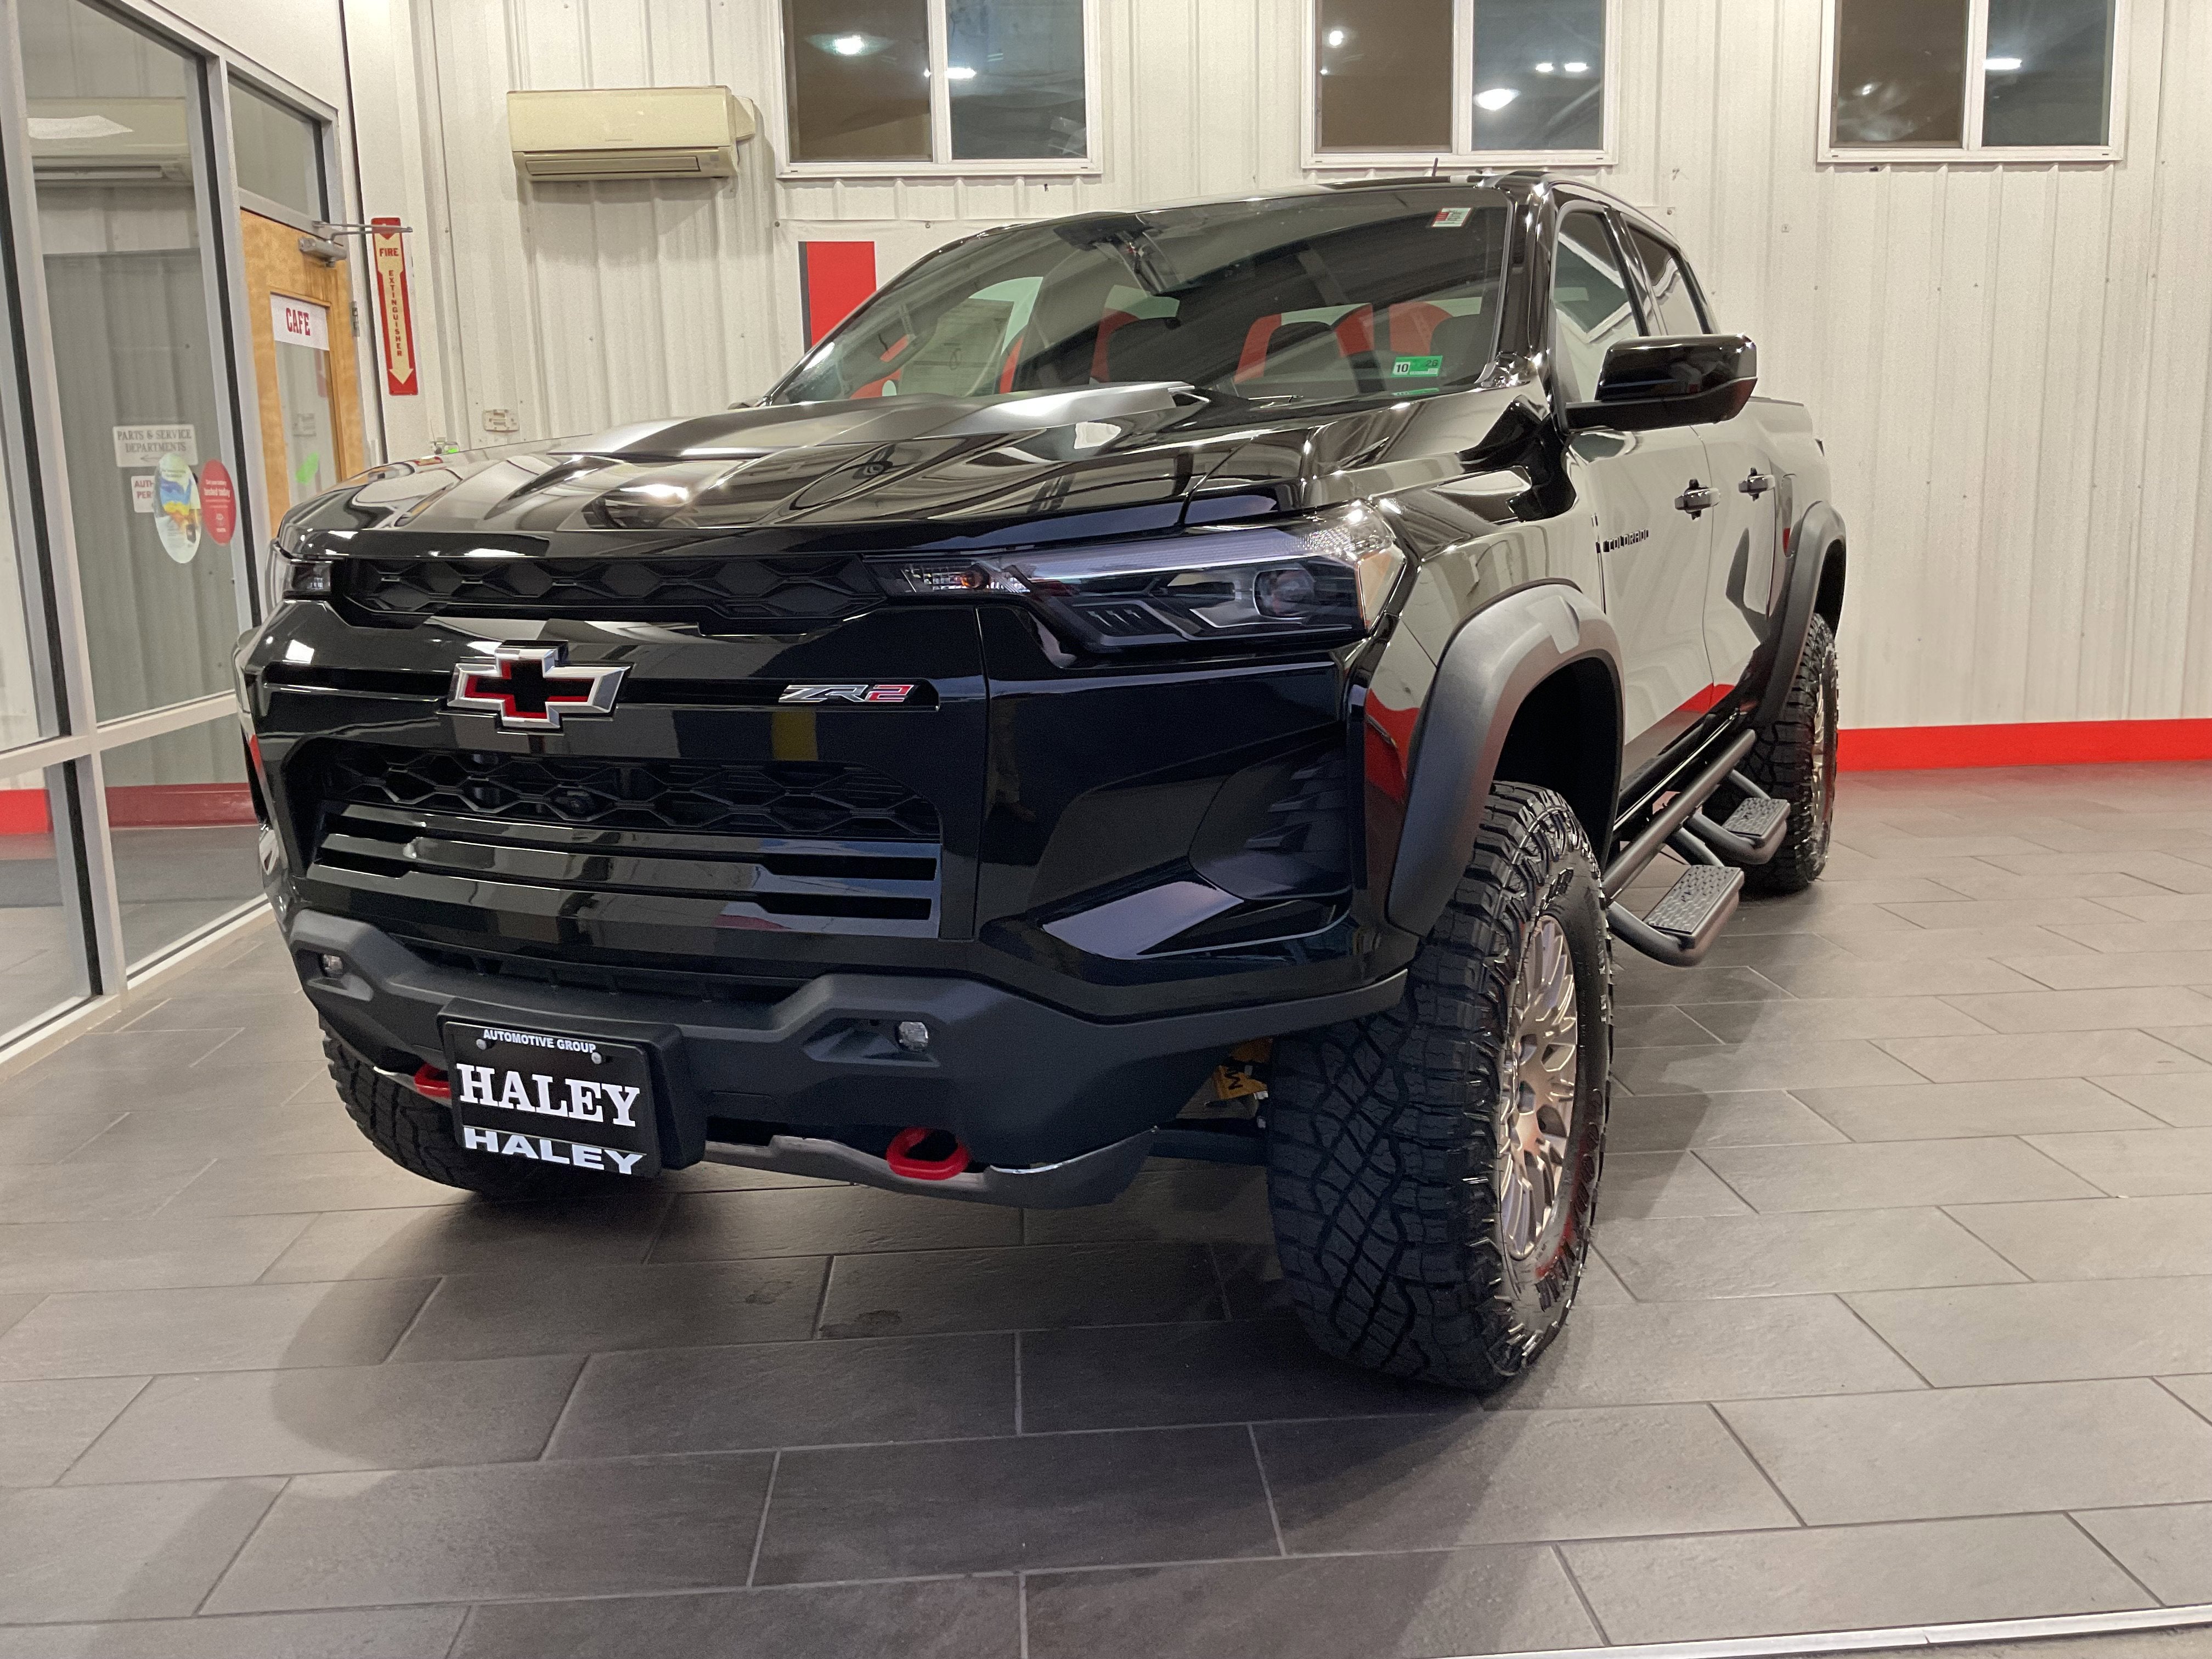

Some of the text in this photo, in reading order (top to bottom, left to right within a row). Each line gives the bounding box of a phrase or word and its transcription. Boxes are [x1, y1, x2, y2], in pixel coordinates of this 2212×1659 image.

[379, 247, 399, 257] FIRE
[285, 307, 311, 336] CAFE
[388, 270, 403, 357] EXTINGUISHER
[1396, 364, 1409, 373] 10
[117, 429, 191, 441] PARTS & SERVICE
[125, 442, 187, 453] DEPARTMENTS
[778, 684, 914, 703] ZR2
[483, 1029, 596, 1054] AUTOMOTIVE GROUP
[456, 1063, 640, 1127] HALEY
[463, 1127, 644, 1175] HALEY
